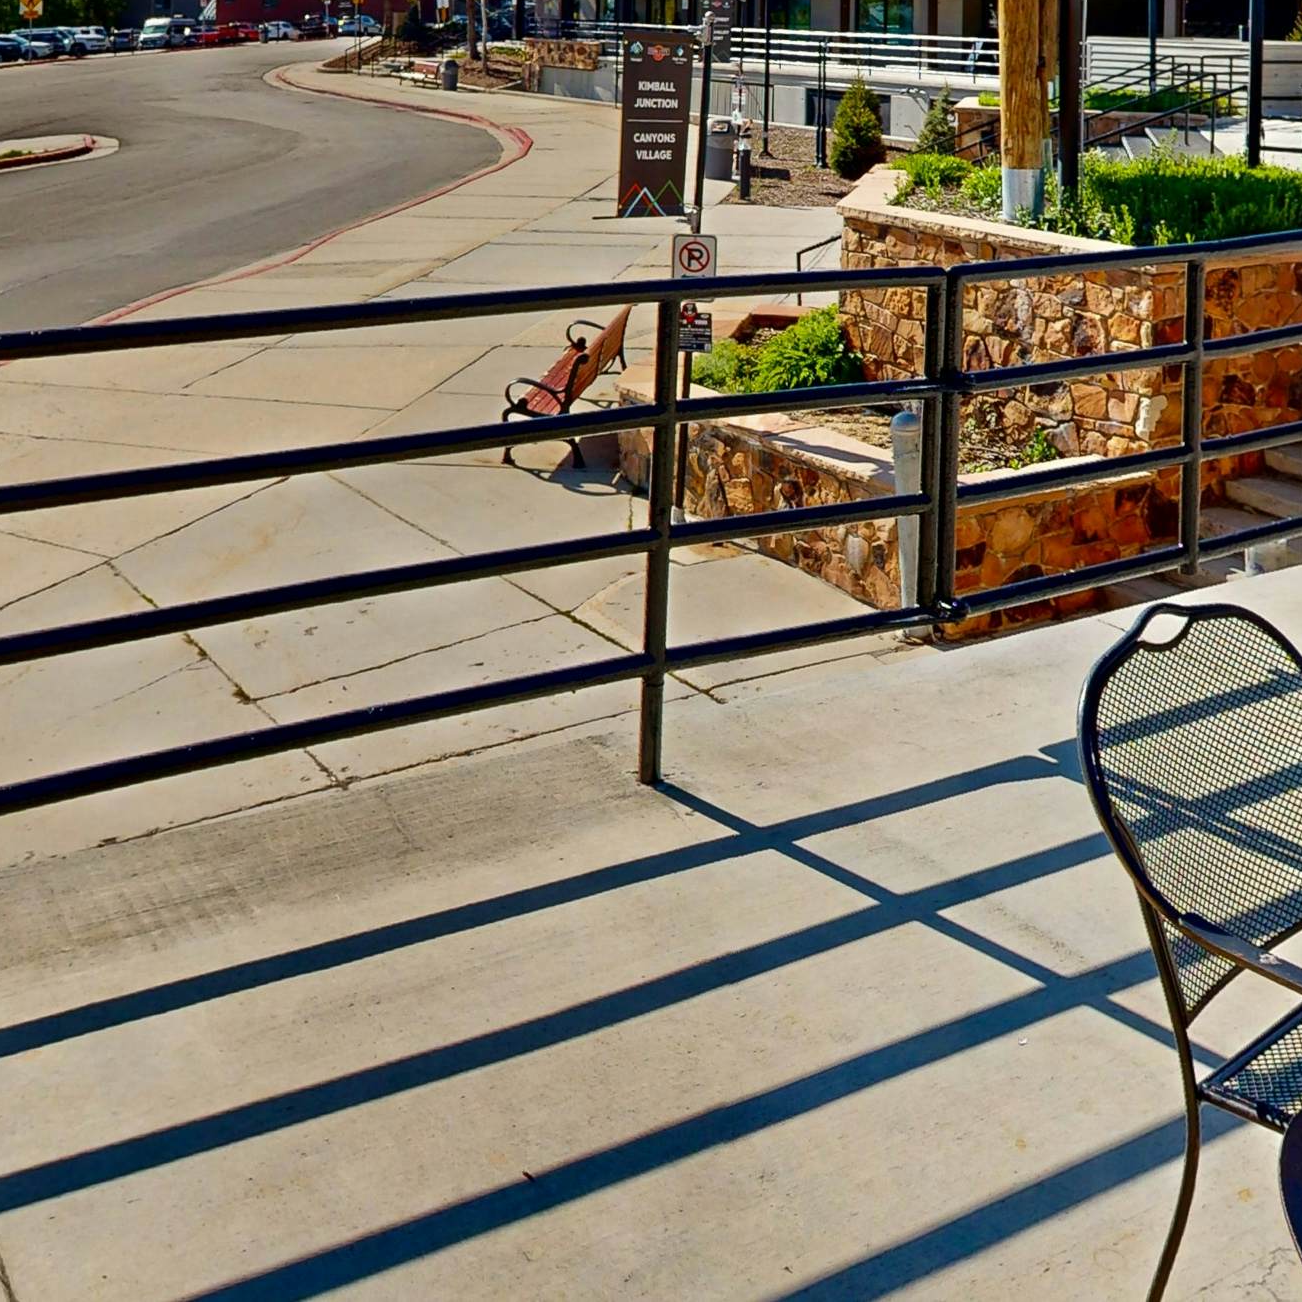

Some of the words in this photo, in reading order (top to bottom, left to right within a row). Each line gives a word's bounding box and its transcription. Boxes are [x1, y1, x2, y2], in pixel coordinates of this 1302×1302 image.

[638, 81, 676, 92] KIMBALL
[634, 98, 678, 109] JUNCTION
[633, 133, 676, 143] CANYONS
[636, 150, 672, 160] VILLAGE
